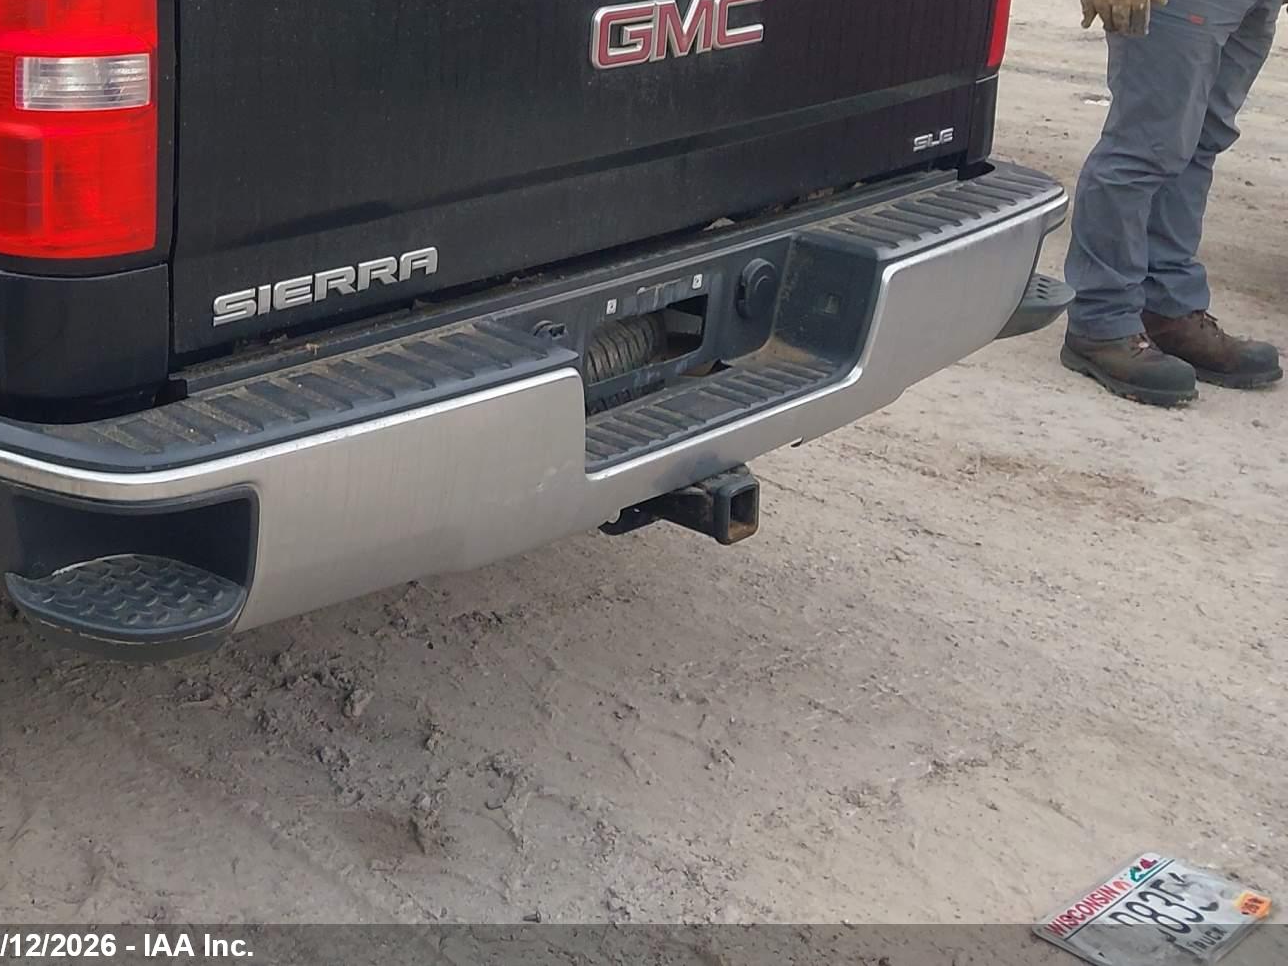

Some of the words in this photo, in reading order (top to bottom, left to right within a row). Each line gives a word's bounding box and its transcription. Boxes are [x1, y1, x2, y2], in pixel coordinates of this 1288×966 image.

[913, 127, 954, 152] SLE
[212, 246, 439, 327] SIERRA
[1044, 886, 1122, 938] WISCONSIN
